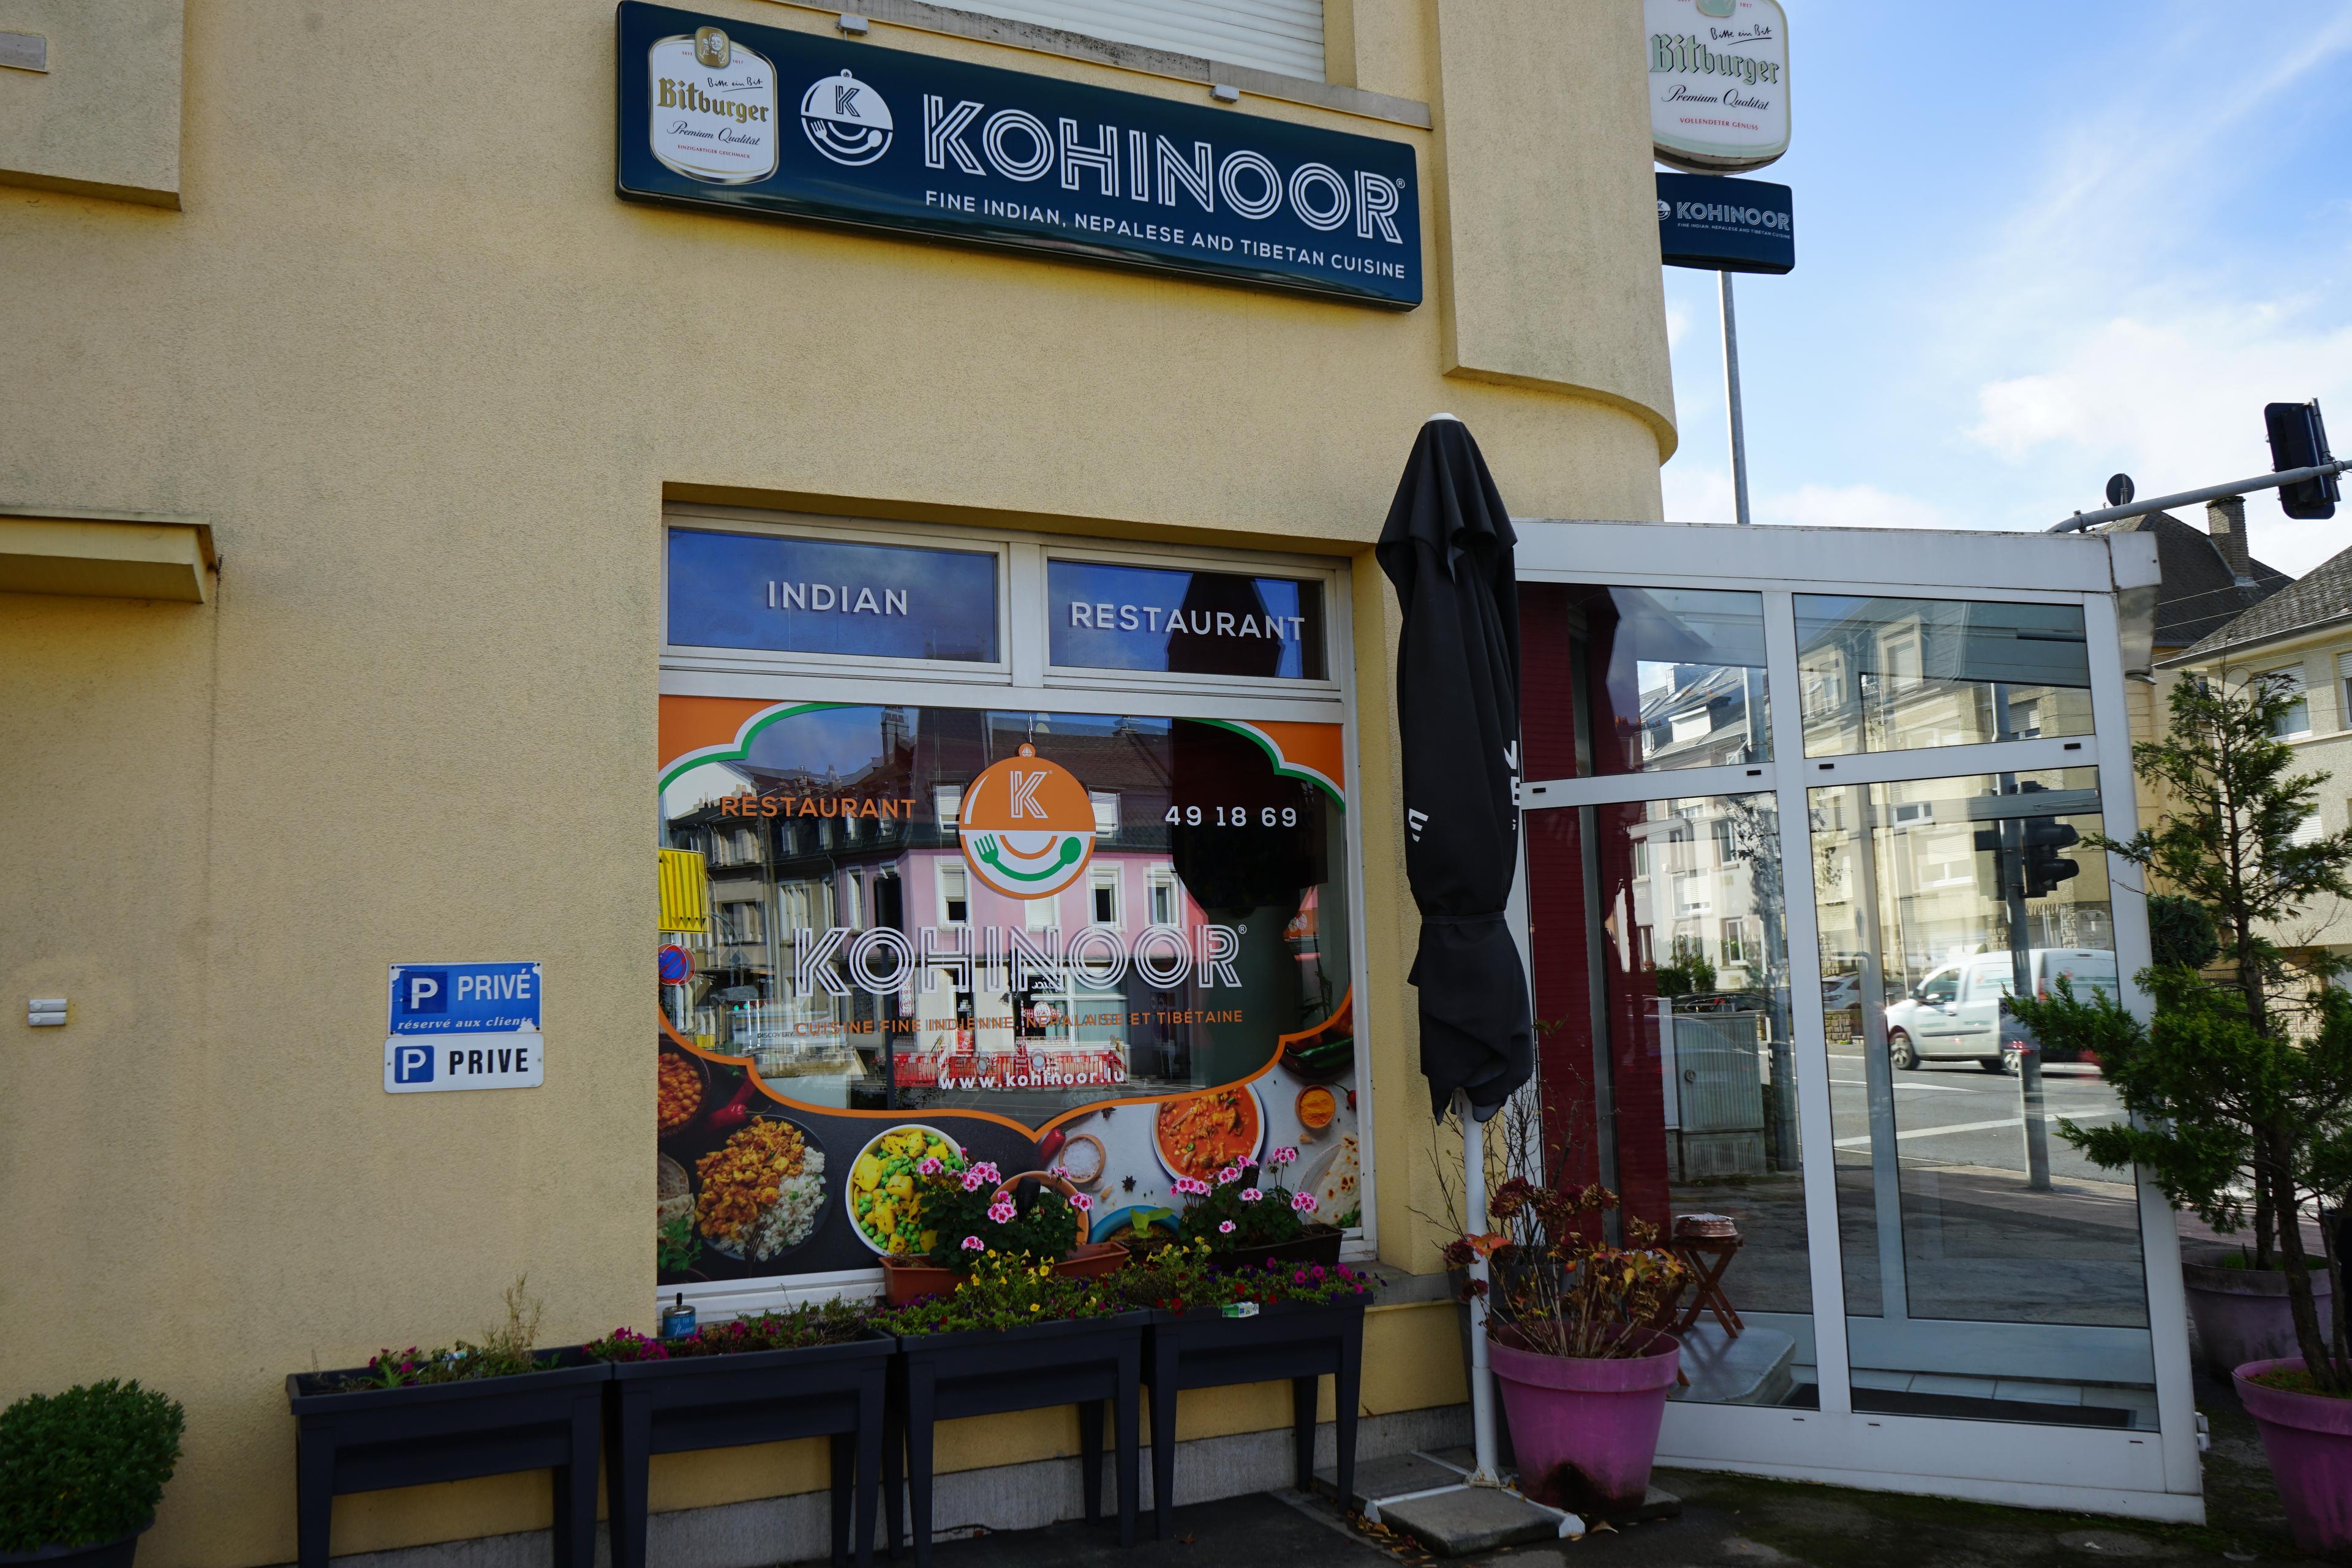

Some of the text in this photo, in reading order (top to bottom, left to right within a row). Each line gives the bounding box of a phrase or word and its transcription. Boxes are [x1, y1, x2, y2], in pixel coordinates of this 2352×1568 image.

[1710, 28, 1735, 40] Bitte
[1754, 24, 1773, 36] Bit
[1649, 34, 1779, 85] Bitburger
[707, 77, 729, 88] Bitte
[747, 77, 763, 86] Bit
[657, 77, 769, 123] Bitburger
[835, 85, 861, 118] K
[1661, 85, 1770, 110] Premium Qualität
[666, 120, 761, 146] Premium Qualität
[1679, 118, 1759, 130] VOLLENDETER GENUSS
[678, 144, 750, 159] EINZIGARTIGER GESCHMACK
[926, 190, 1404, 279] FINE INDIAN, NEPALESE AND TIBETAN CUISINE
[769, 581, 907, 616] INDIAN
[1071, 601, 1305, 641] RESTAURANT
[721, 796, 916, 819] RESTAURANT
[1165, 805, 1297, 827] 49 18 69
[410, 968, 531, 1009] P PRIVÉ
[398, 1019, 451, 1030] réservé
[455, 1019, 481, 1028] aux
[796, 1020, 873, 1036] CUISINE
[880, 1019, 921, 1034] FINE
[929, 1016, 1019, 1031] INDIENNE,
[1131, 1012, 1150, 1025] ET
[1156, 1008, 1243, 1024] TIBÉTAINE
[402, 1047, 529, 1080] P PRIVE
[940, 1068, 1125, 1090] www.kohinoor.lu
